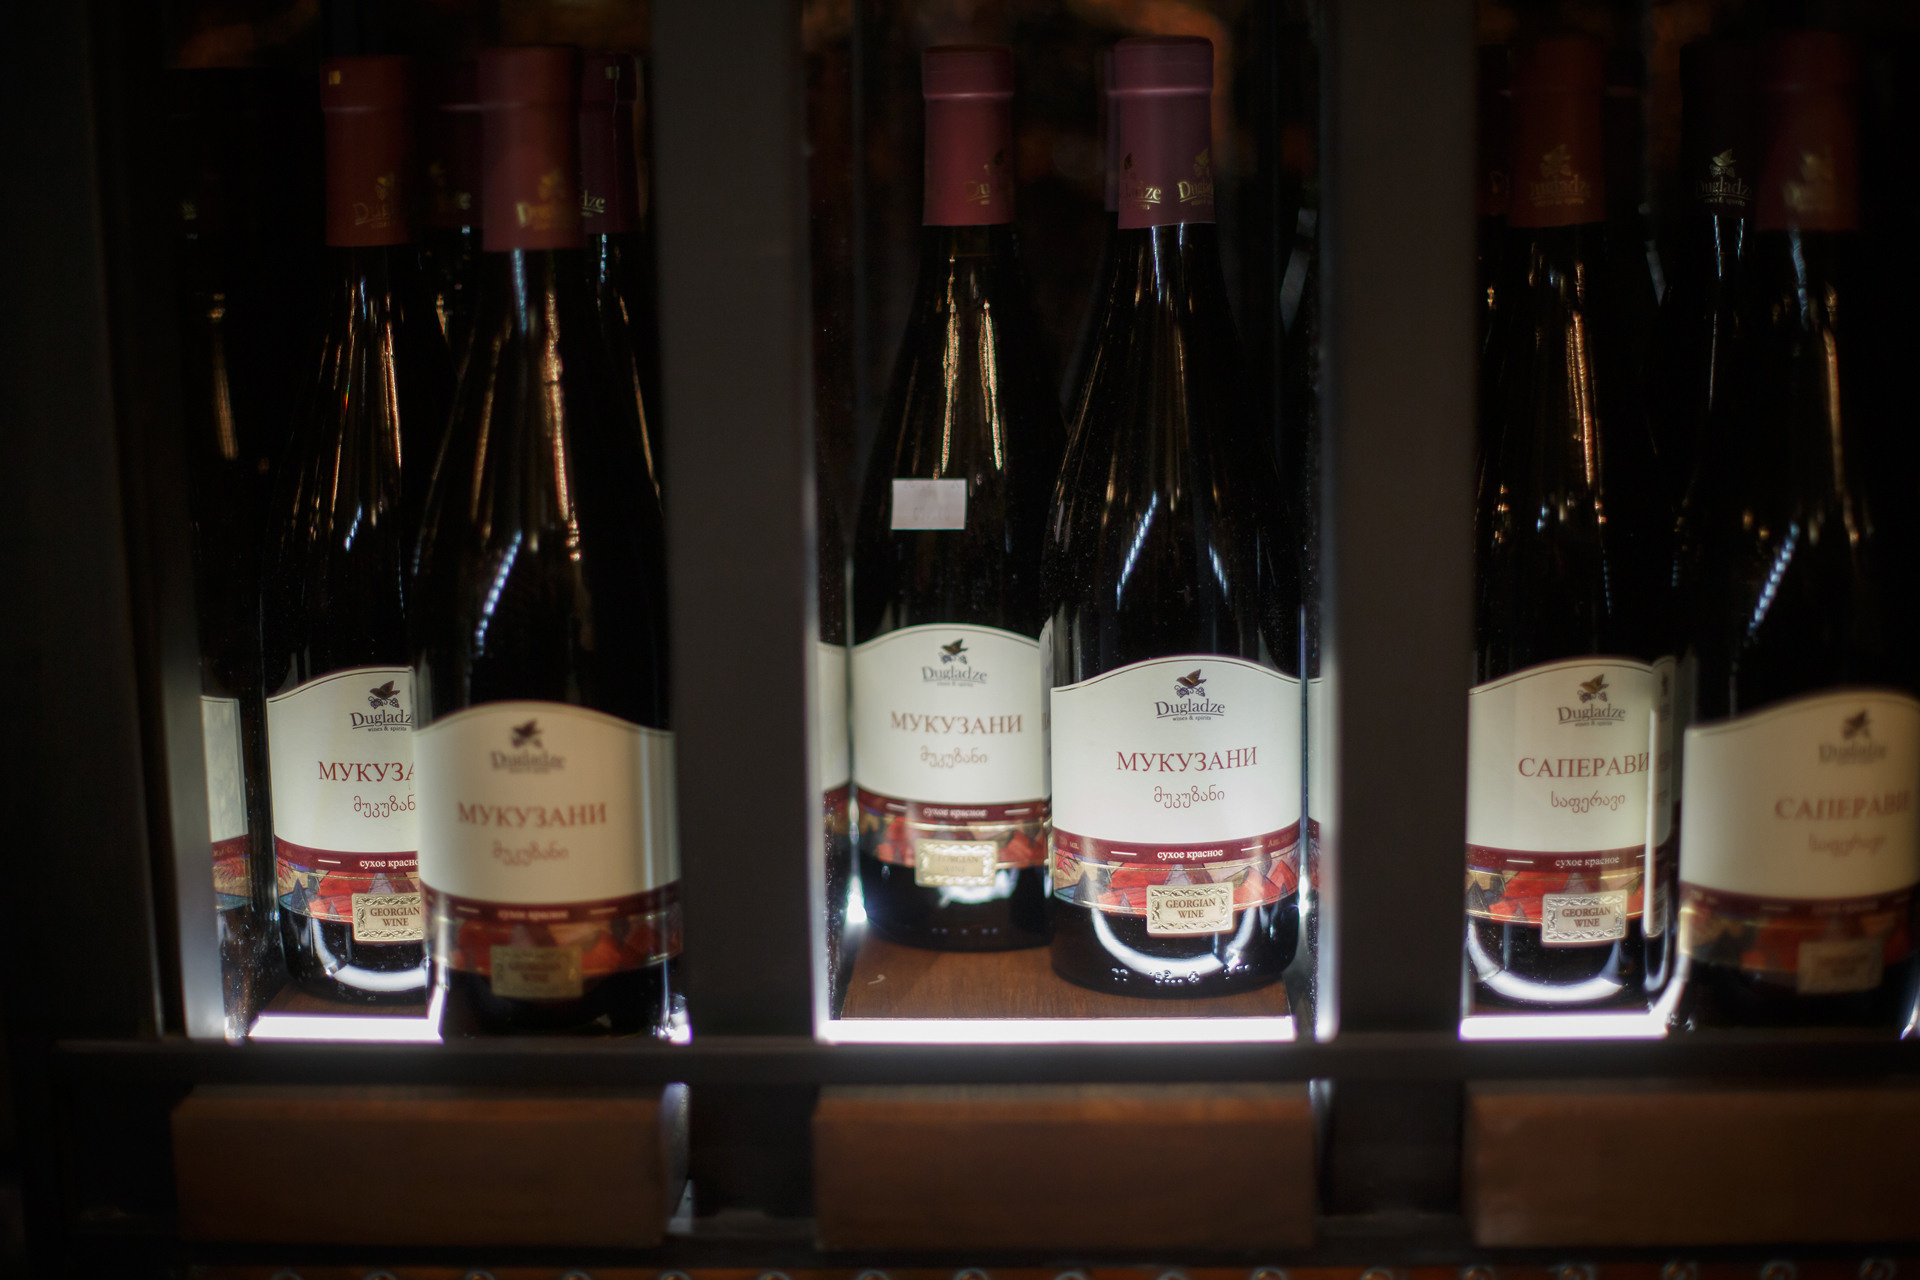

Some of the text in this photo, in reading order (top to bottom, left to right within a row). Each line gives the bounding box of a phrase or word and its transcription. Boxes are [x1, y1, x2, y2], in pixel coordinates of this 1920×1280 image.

[921, 664, 988, 681] Dugladze
[1154, 698, 1225, 716] Dugladze
[1556, 703, 1626, 721] Dugladze
[890, 711, 1023, 735] МУКУЗАНИ
[1116, 746, 1258, 773] МУКУЗАНИ
[1518, 752, 1649, 778] САПЕРАВИ
[1154, 784, 1225, 809] მუკუზანი
[1550, 790, 1626, 814] საფერავი
[458, 801, 607, 827] МУКУЗАНИ
[1157, 848, 1223, 861] сухое красное
[359, 860, 386, 869] сухое
[1555, 856, 1620, 869] сухое красное
[1165, 898, 1216, 909] GEORGIAN
[370, 907, 420, 917] GEORGIAN
[1178, 909, 1204, 919] WINE
[1562, 907, 1611, 917] GEORGIAN
[382, 918, 409, 927] WINE
[1574, 918, 1600, 927] WINE
